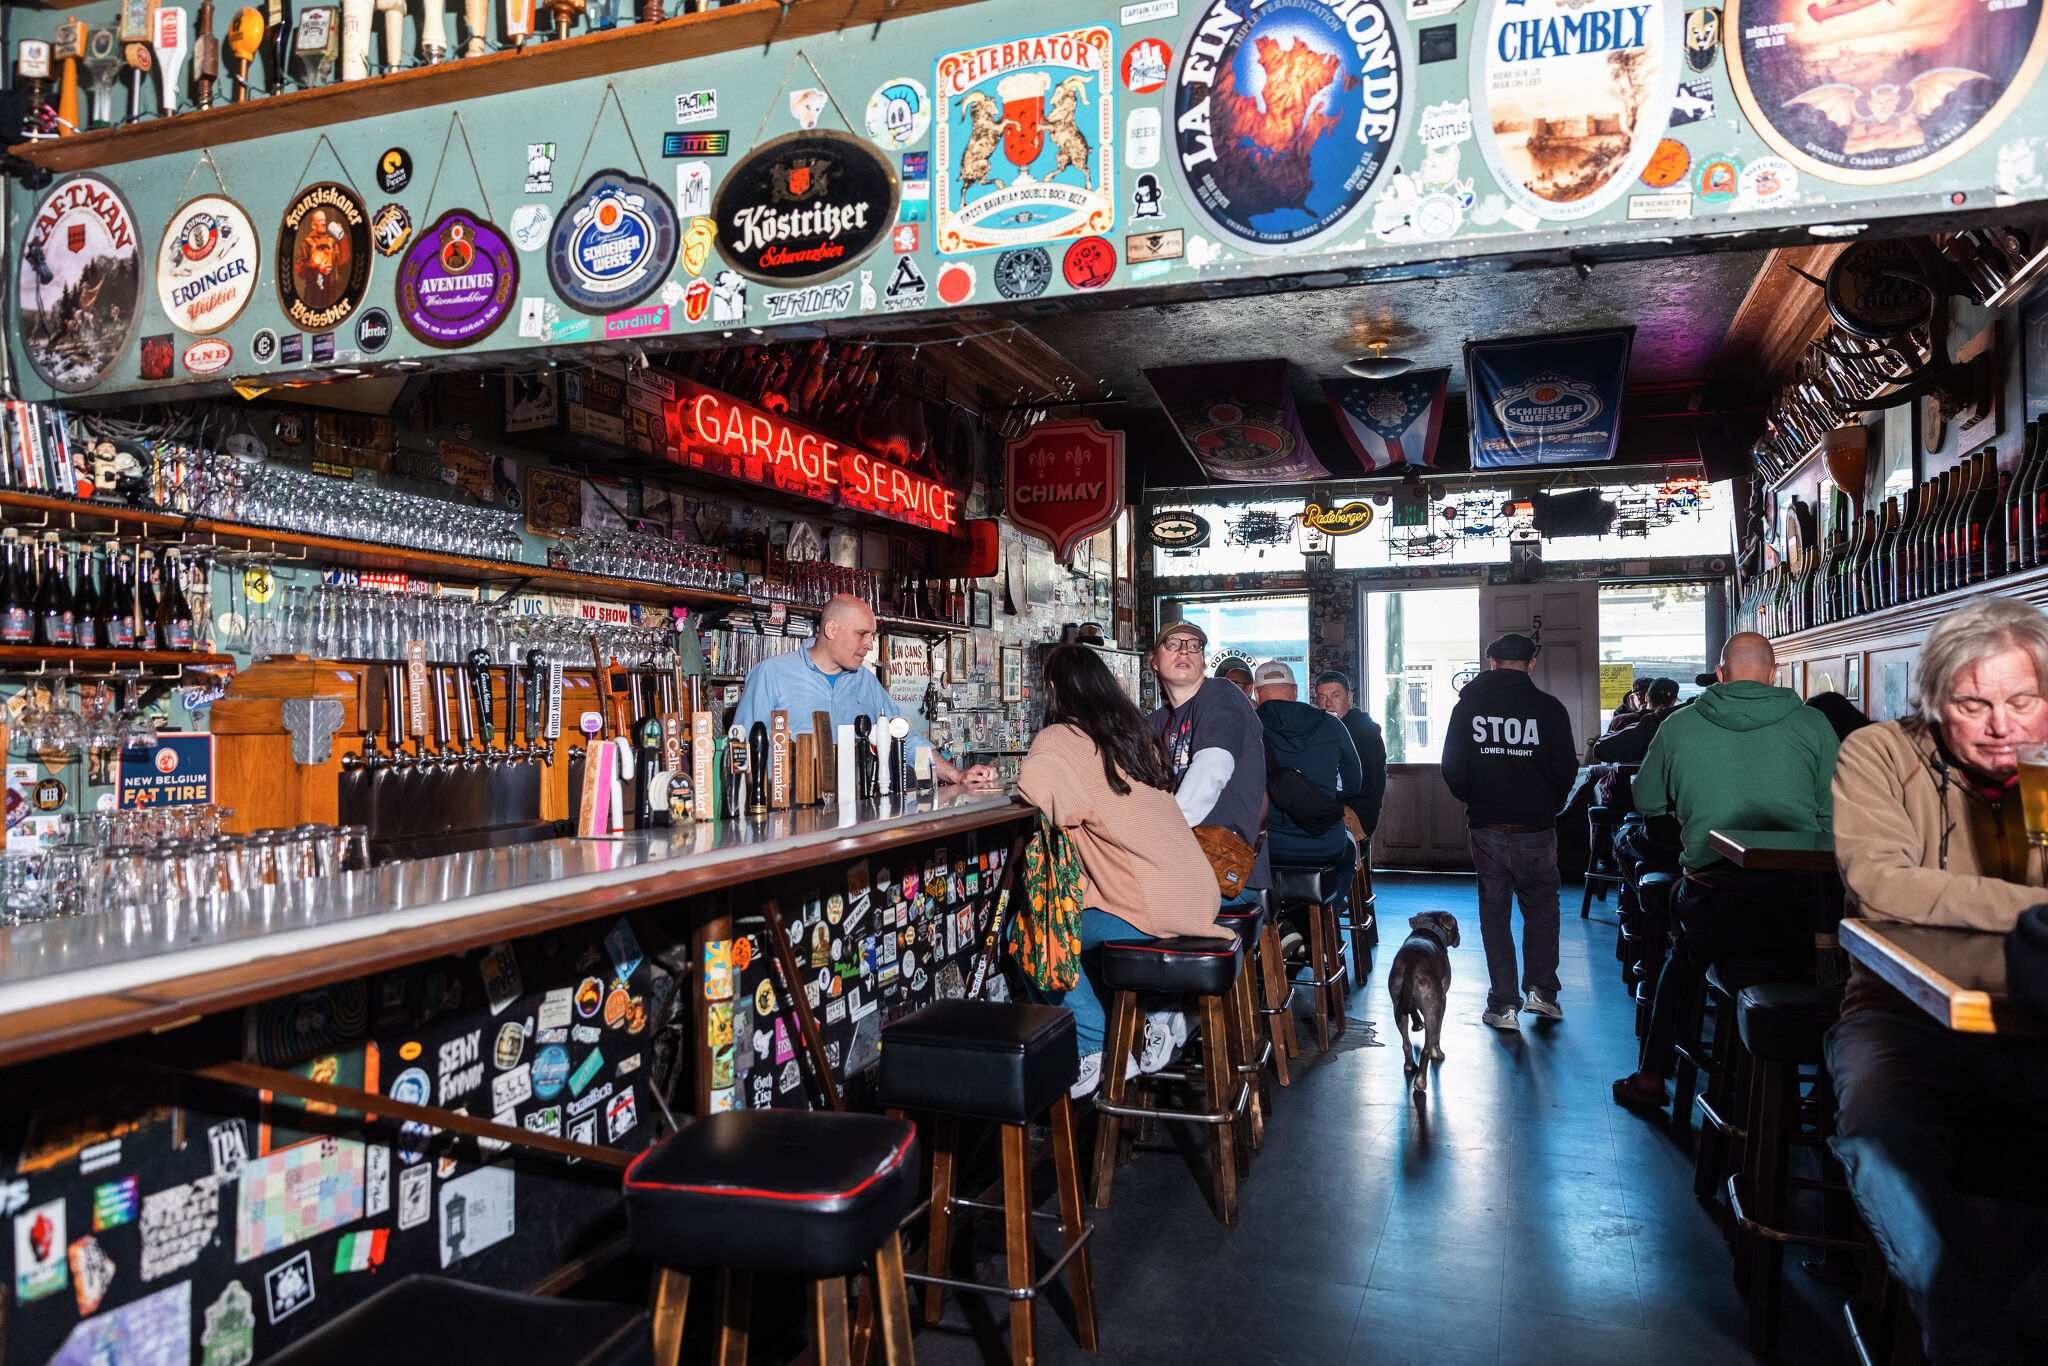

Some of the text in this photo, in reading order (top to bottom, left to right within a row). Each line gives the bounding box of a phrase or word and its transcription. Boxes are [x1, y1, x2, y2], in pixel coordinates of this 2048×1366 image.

[1124, 3, 1176, 18] CAPTAIN FATTY'S
[1230, 0, 1341, 49] TRIPLE FERMENTATION
[1498, 5, 1653, 63] CHAMBLY
[953, 38, 1090, 92] CELEBRATOR
[1178, 0, 1244, 172] LA FIN
[1130, 127, 1157, 139] BEER
[286, 186, 363, 231] Franziskaner
[1020, 187, 1047, 199] DOUBLE
[1068, 191, 1088, 206] BEER
[1633, 199, 1689, 208] DESCHUTES
[30, 184, 133, 250] AFTMAN
[733, 200, 869, 253] Köstritzer
[1321, 205, 1348, 225] CANADA
[181, 213, 216, 242] ERDINGER
[386, 219, 404, 245] 20
[583, 236, 641, 262] SCHNEIDER
[760, 242, 844, 268] Schwarzbier
[593, 252, 632, 272] WEISSE
[171, 258, 249, 308] ERDINGER
[419, 273, 493, 294] AVENTINUS
[186, 285, 237, 321] Weißbier
[290, 298, 351, 327] Weissbier
[1508, 404, 1583, 416] SCHNEIDER
[1520, 413, 1571, 422] WEISSE
[695, 395, 956, 526] GARAGE SERVICE
[1014, 482, 1105, 506] CHIMAY
[1151, 514, 1197, 527] Dogfish Head
[1304, 504, 1369, 528] Radeberger
[1149, 532, 1163, 542] Craft
[361, 571, 406, 583] MEDICAL
[582, 605, 629, 624] NO SHOW
[894, 645, 923, 659] EW CANS
[904, 661, 931, 677] BOTTLES
[184, 688, 225, 709] Cheers
[411, 662, 425, 731] Cellarmaker
[550, 664, 562, 736] BROOKS DRY CIDER
[1472, 716, 1540, 745] STOA
[1507, 749, 1533, 757] HAIGHT
[124, 773, 207, 786] NEW BELGIUM
[695, 736, 710, 815] Cellarmaker
[774, 732, 787, 803] Cellarmaker
[124, 785, 207, 804] FAT TIRE
